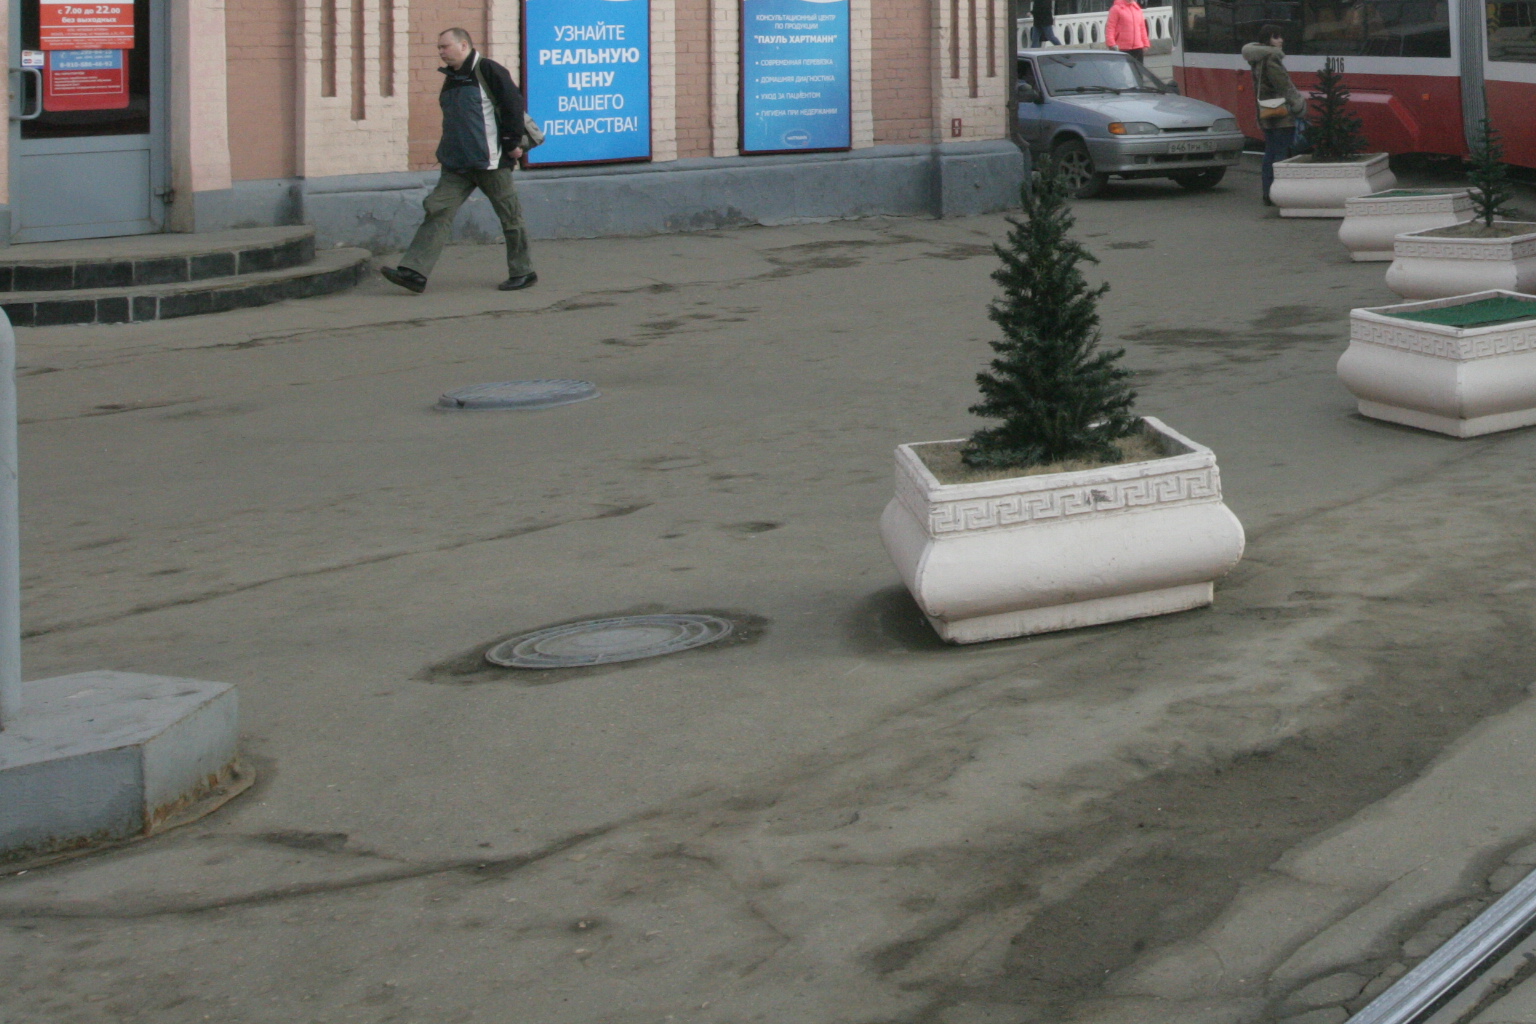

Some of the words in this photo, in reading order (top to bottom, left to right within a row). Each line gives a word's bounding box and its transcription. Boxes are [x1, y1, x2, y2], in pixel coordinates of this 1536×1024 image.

[64, 6, 82, 14] 7.00
[96, 6, 121, 14] 22.00
[554, 21, 626, 42] УЗНАЙТЕ
[754, 35, 788, 44] "ПАУЛЬ
[789, 35, 838, 44] ХАРТМАНН"
[539, 47, 640, 65] РЕАЛЬНУЮ
[567, 71, 615, 91] ЦЕНУ
[558, 93, 625, 112] ВАШЕГО
[543, 116, 639, 136] ЛЕКАРСТВА!
